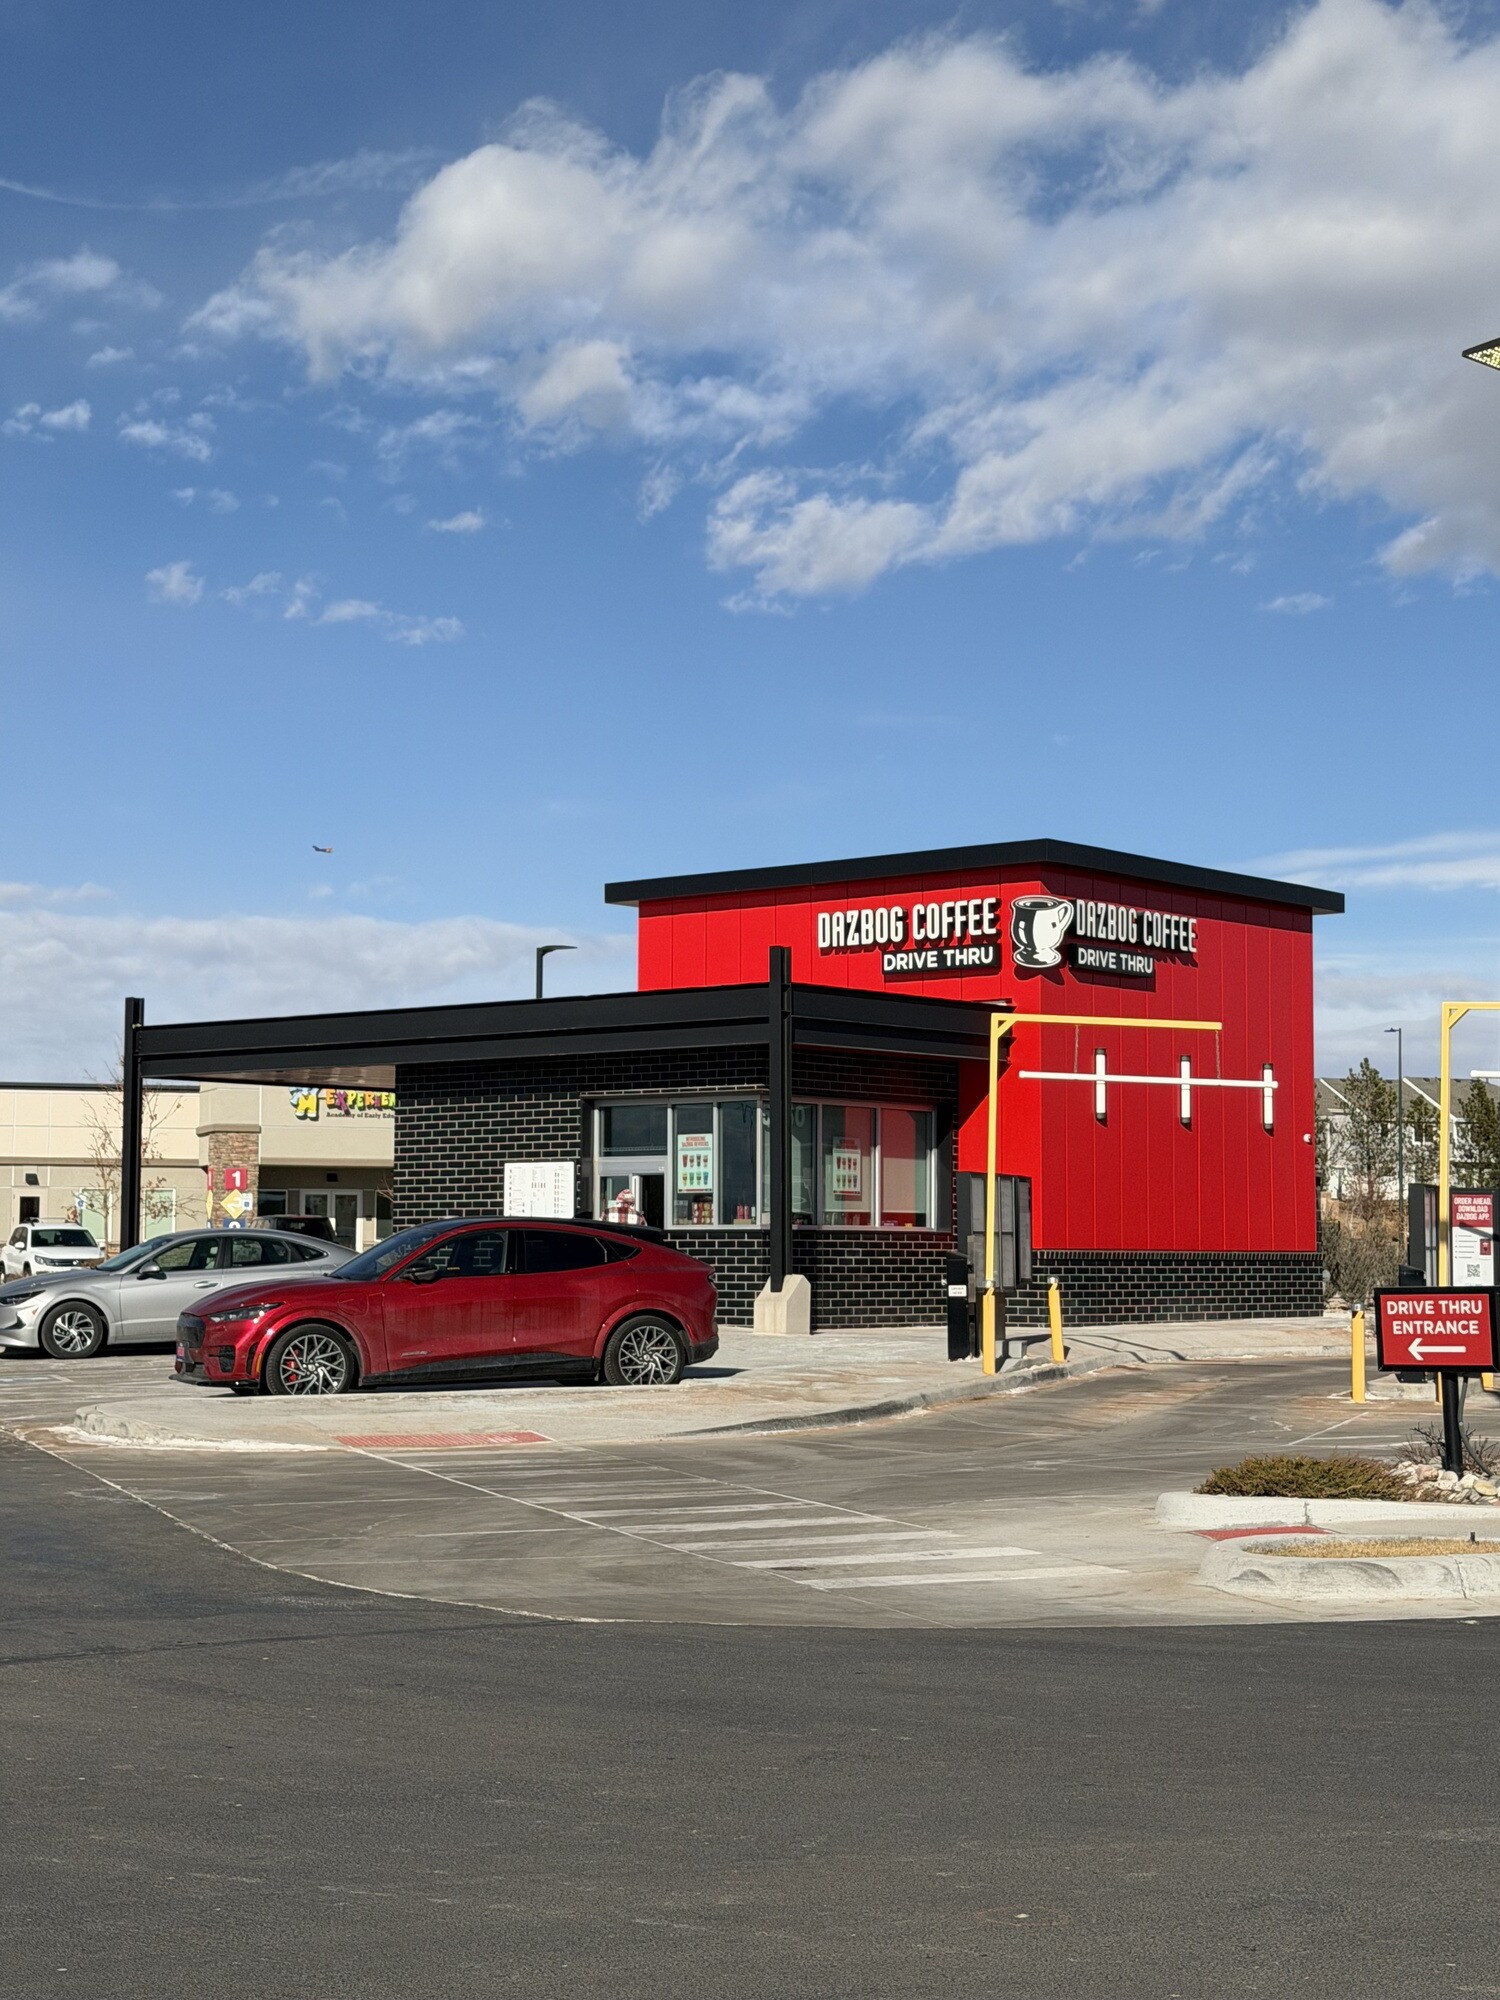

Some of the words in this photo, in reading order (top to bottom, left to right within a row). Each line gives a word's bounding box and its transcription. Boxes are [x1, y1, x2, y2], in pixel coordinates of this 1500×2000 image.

[817, 906, 904, 948] DAZBOG
[912, 897, 997, 940] COFFEE
[1076, 899, 1138, 944] DAZBOG
[1143, 910, 1198, 953] COFFEE
[883, 951, 938, 971] DRIVE
[943, 946, 993, 967] THRU
[1078, 947, 1117, 969] DRIVE
[1119, 953, 1154, 974] THRU
[231, 1170, 241, 1188] 1
[1453, 1197, 1472, 1205] ORDER
[1386, 1300, 1435, 1315] DRIVE
[1438, 1299, 1483, 1314] THRU
[1392, 1320, 1480, 1335] ENTRANCE
